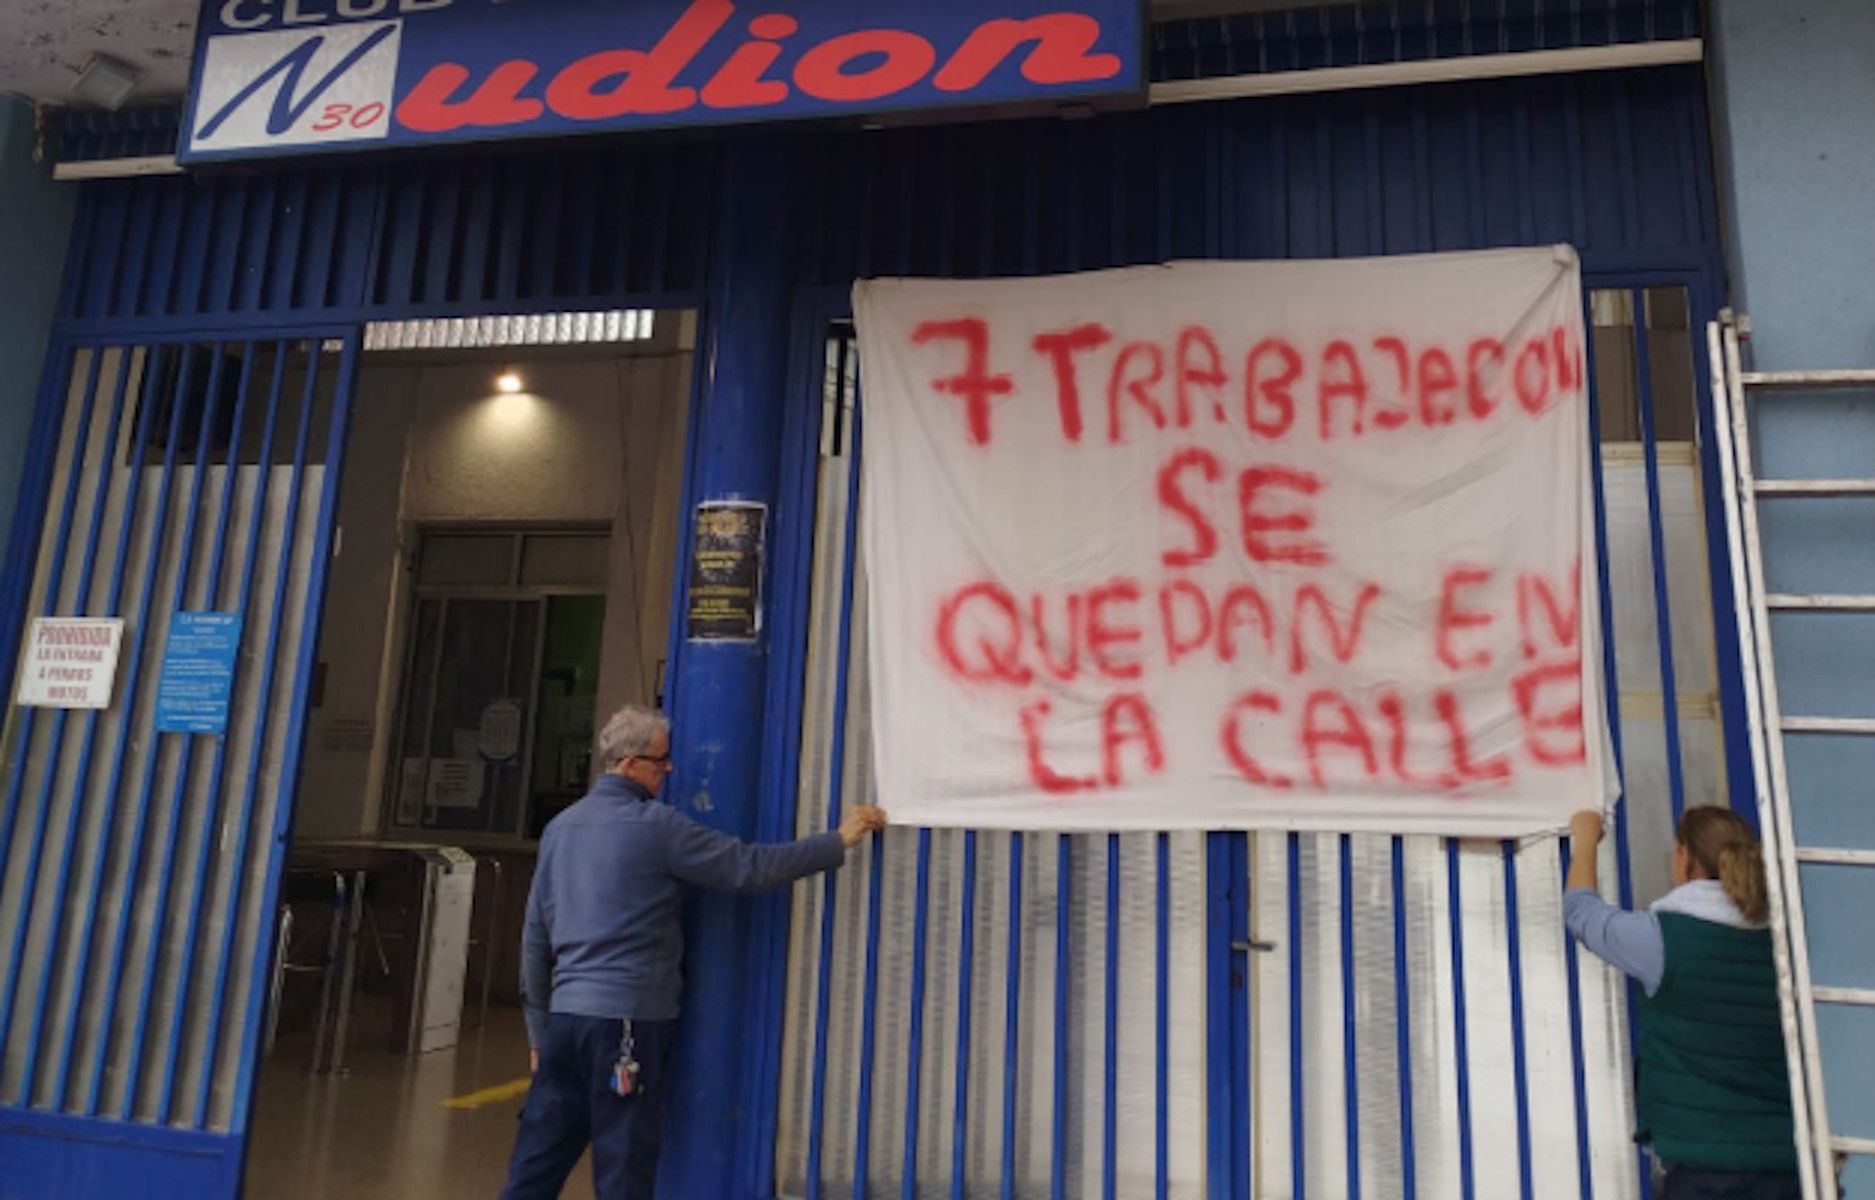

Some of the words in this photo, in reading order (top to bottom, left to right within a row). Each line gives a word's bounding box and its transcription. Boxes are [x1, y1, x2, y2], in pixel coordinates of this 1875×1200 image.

[312, 102, 385, 132] 30
[911, 316, 1014, 447] 7
[1155, 446, 1330, 569] SE
[933, 576, 1381, 687] QUEDAN
[1435, 552, 1581, 673] EN
[1019, 692, 1166, 796] LA
[1220, 660, 1586, 793] CALLE
